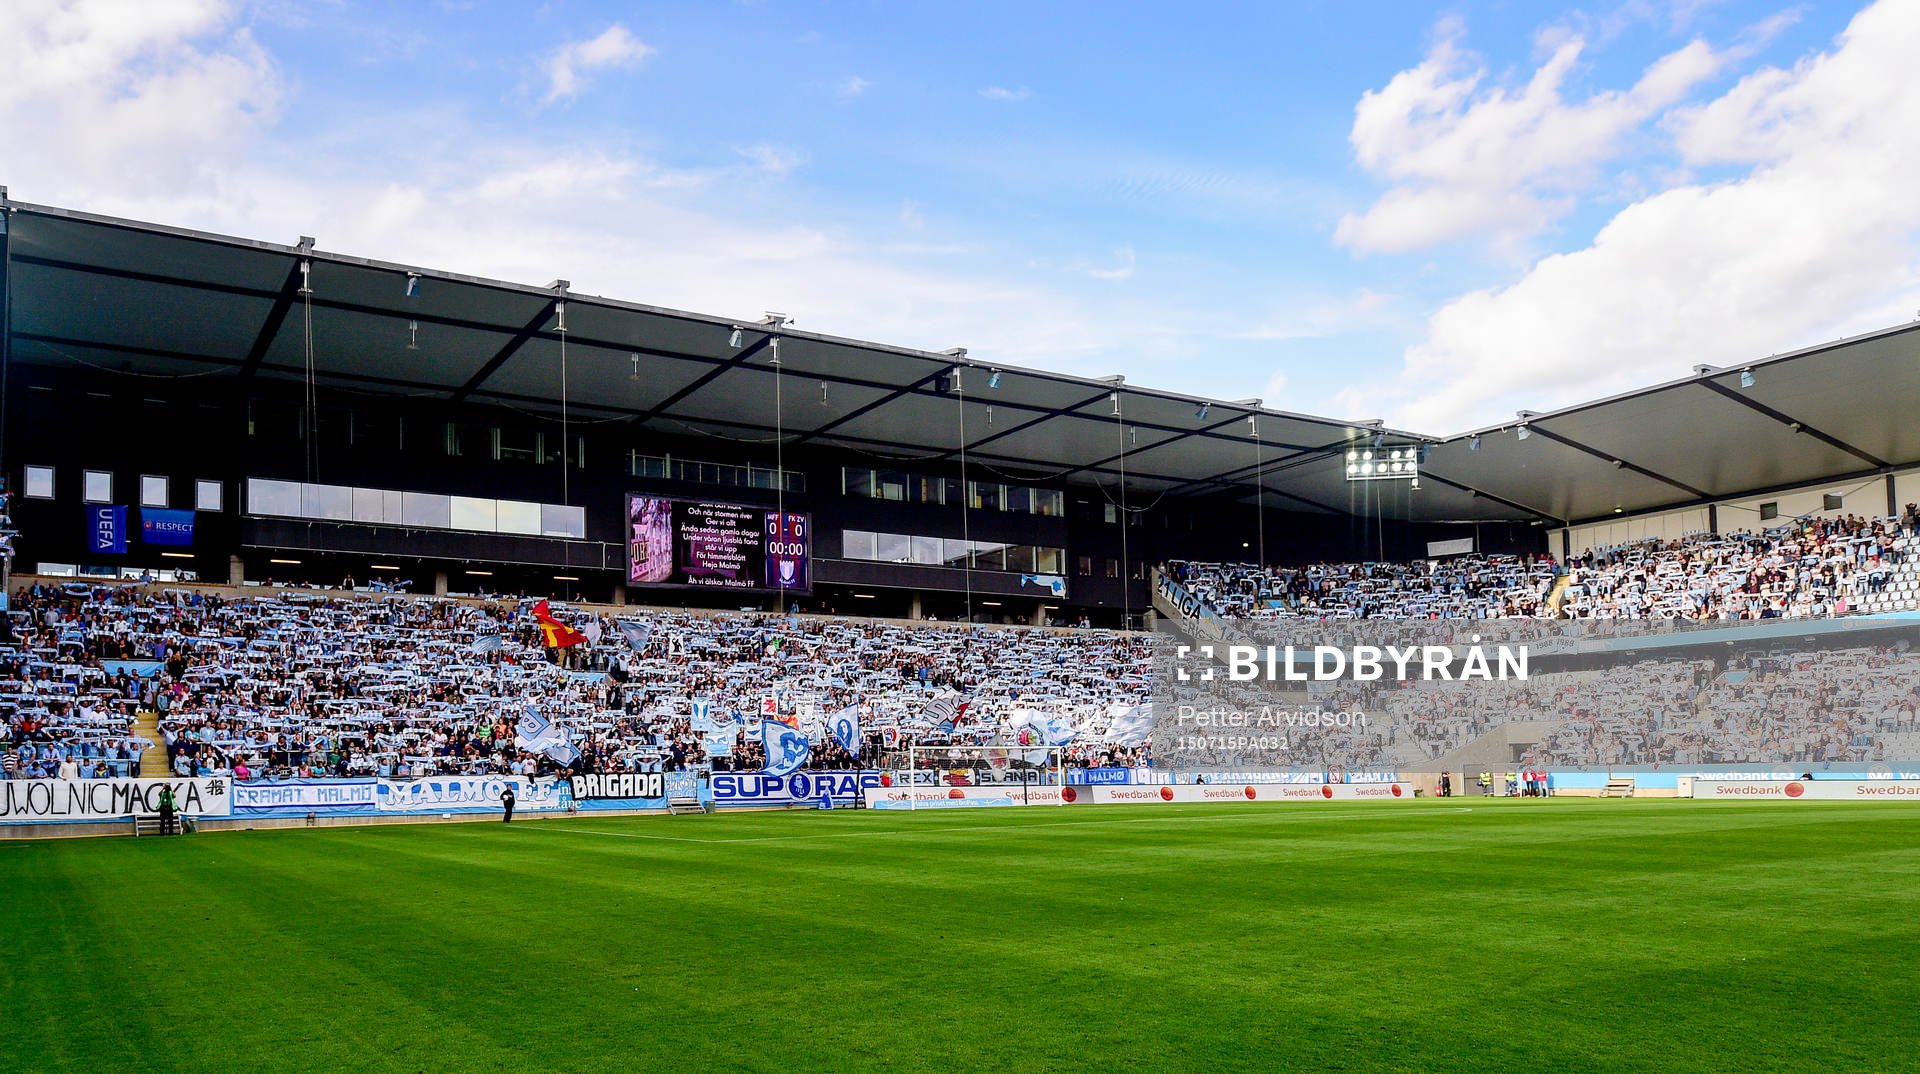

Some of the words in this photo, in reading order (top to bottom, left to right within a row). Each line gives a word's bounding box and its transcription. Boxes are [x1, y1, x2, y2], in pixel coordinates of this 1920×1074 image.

[688, 507, 702, 516] Och
[98, 508, 112, 549] UEFA
[155, 522, 193, 532] RESPECT
[683, 533, 703, 541] Under
[769, 541, 803, 556] 00:00
[571, 774, 663, 799] BRIGADA
[1716, 785, 1782, 795] Swedbank
[1005, 790, 1059, 801] Swedbank
[1111, 790, 1159, 799] Swedbank
[1203, 789, 1244, 798] Swedbank
[1283, 788, 1321, 797] Swedbank
[1355, 787, 1391, 796] Swedbank
